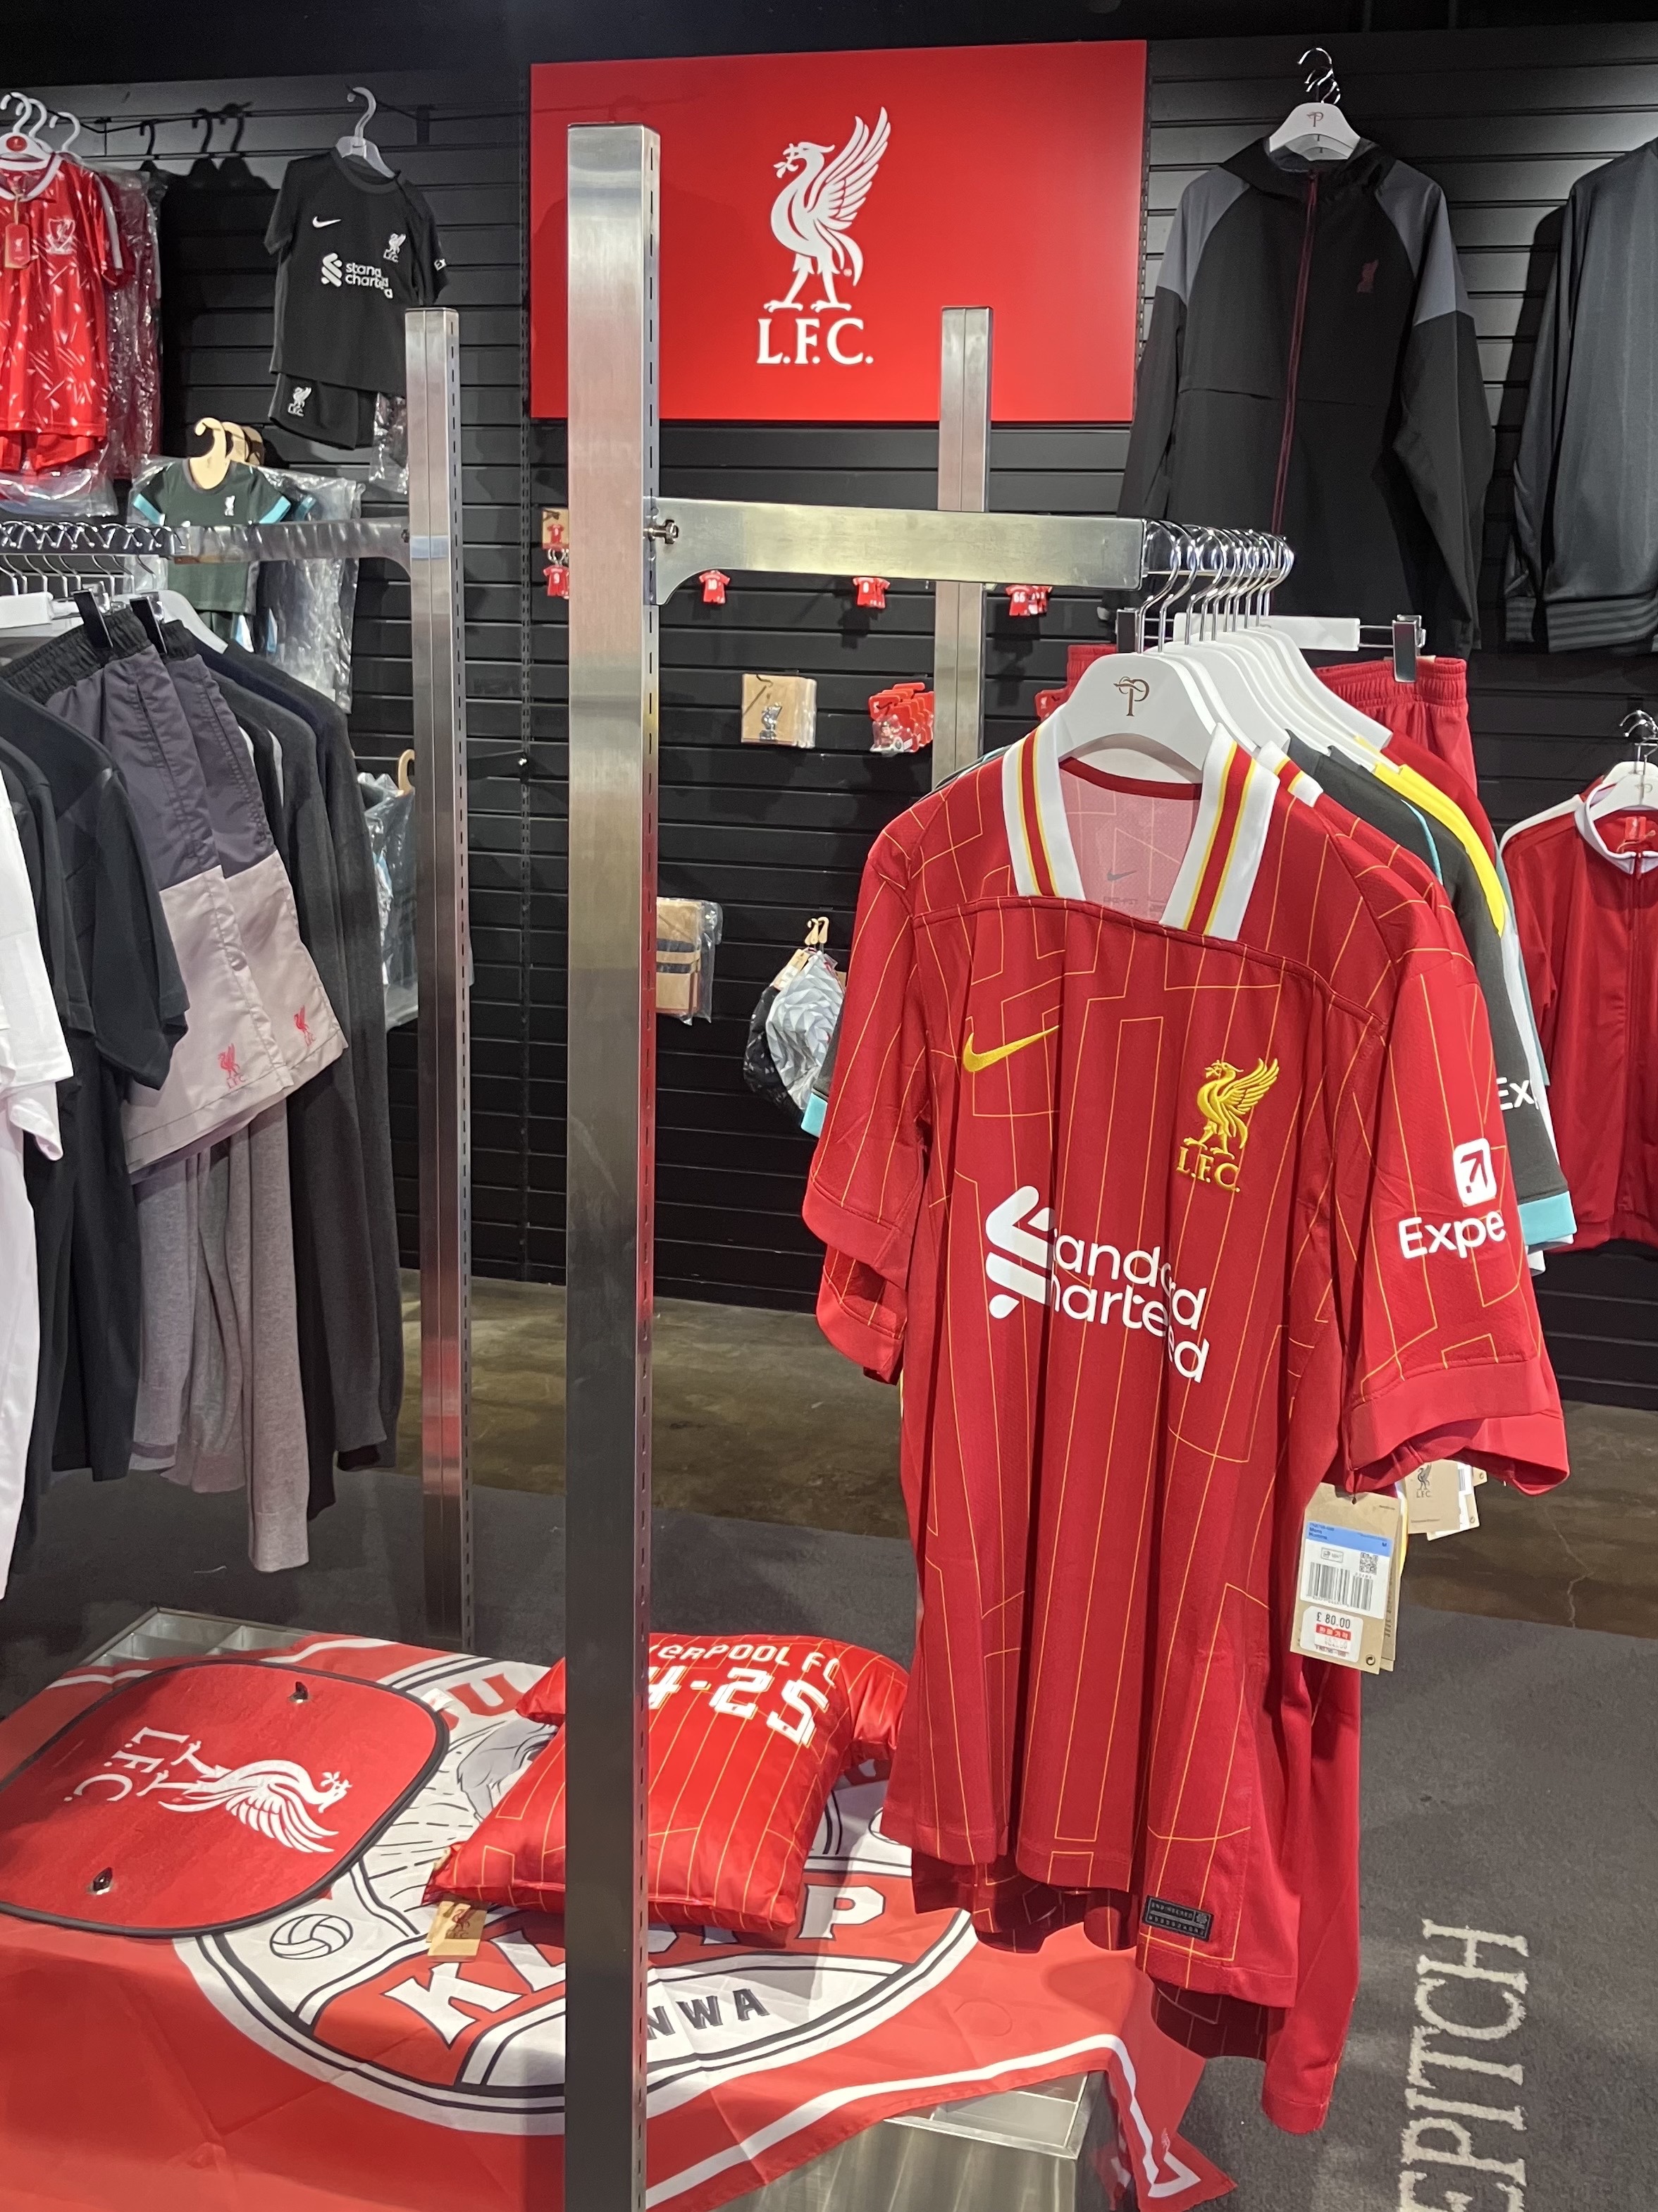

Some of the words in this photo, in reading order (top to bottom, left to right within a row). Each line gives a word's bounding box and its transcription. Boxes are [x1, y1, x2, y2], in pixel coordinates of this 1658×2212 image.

[757, 317, 874, 365] L.F.C.
[1496, 1077, 1540, 1111] Ex
[1175, 1146, 1241, 1193] L.F.C.
[1316, 1612, 1322, 1622] £
[1325, 1613, 1351, 1629] 80.00
[63, 1726, 190, 1802] L.F.C.
[379, 1883, 886, 2050] KLP
